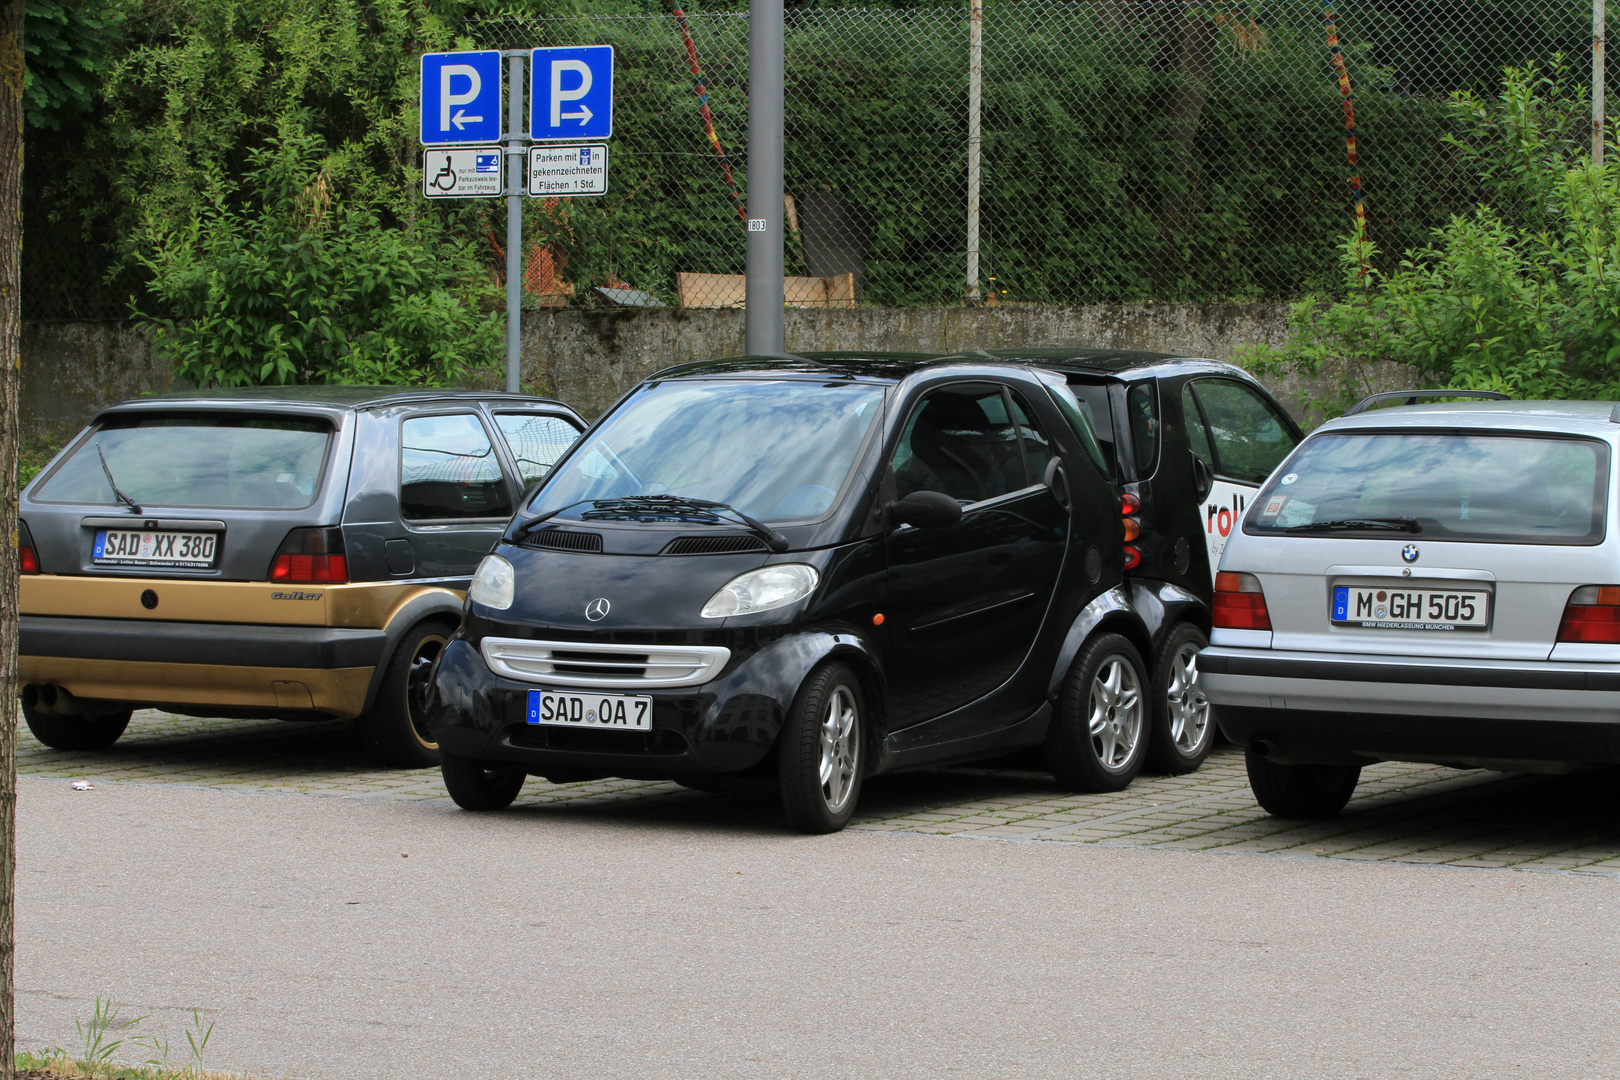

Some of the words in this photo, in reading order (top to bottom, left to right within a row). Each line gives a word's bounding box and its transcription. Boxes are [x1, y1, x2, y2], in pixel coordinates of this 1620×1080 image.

[440, 64, 482, 131] P
[550, 59, 593, 127] P
[536, 153, 562, 162] Parken
[565, 152, 577, 161] mit
[592, 152, 600, 160] in
[533, 166, 603, 178] gekennzeichneten
[539, 180, 570, 190] Flächen
[574, 180, 578, 188] 1
[580, 179, 596, 189] Std.
[749, 221, 766, 230] 1803
[96, 546, 101, 554] D
[105, 532, 141, 556] SAD
[152, 534, 177, 557] XX
[179, 535, 215, 559] 380
[1211, 541, 1219, 557] by
[1337, 606, 1344, 614] D
[1356, 591, 1373, 617] M
[1389, 593, 1422, 619] GH
[1428, 594, 1476, 621] 505
[531, 710, 537, 718] D
[541, 695, 583, 722] SAD
[598, 698, 627, 725] OA
[634, 700, 648, 726] 7
